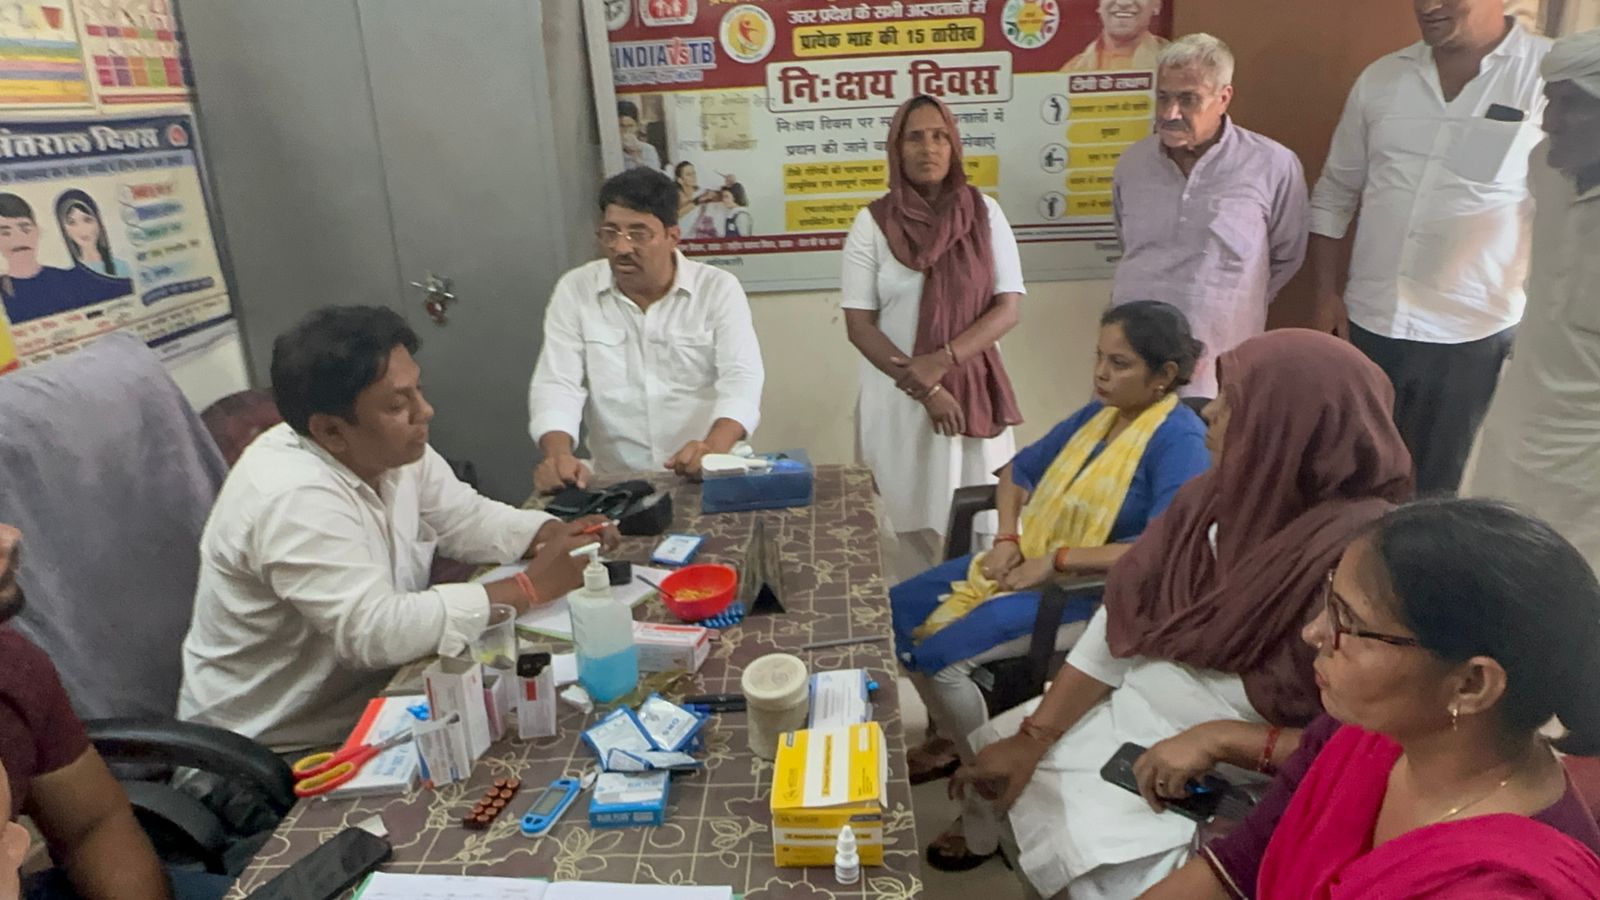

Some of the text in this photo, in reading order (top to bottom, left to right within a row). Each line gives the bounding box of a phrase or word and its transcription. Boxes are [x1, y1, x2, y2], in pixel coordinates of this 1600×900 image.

[819, 5, 852, 23] प्रदेश
[855, 4, 870, 20] के
[874, 3, 903, 18] सभी
[799, 23, 976, 50] प्रत्येक माह की 15 तारीख
[615, 44, 667, 69] INDIA
[691, 41, 715, 64] TB
[908, 60, 1000, 97] दिवस
[857, 117, 875, 129] पर
[89, 125, 160, 151] दिवस
